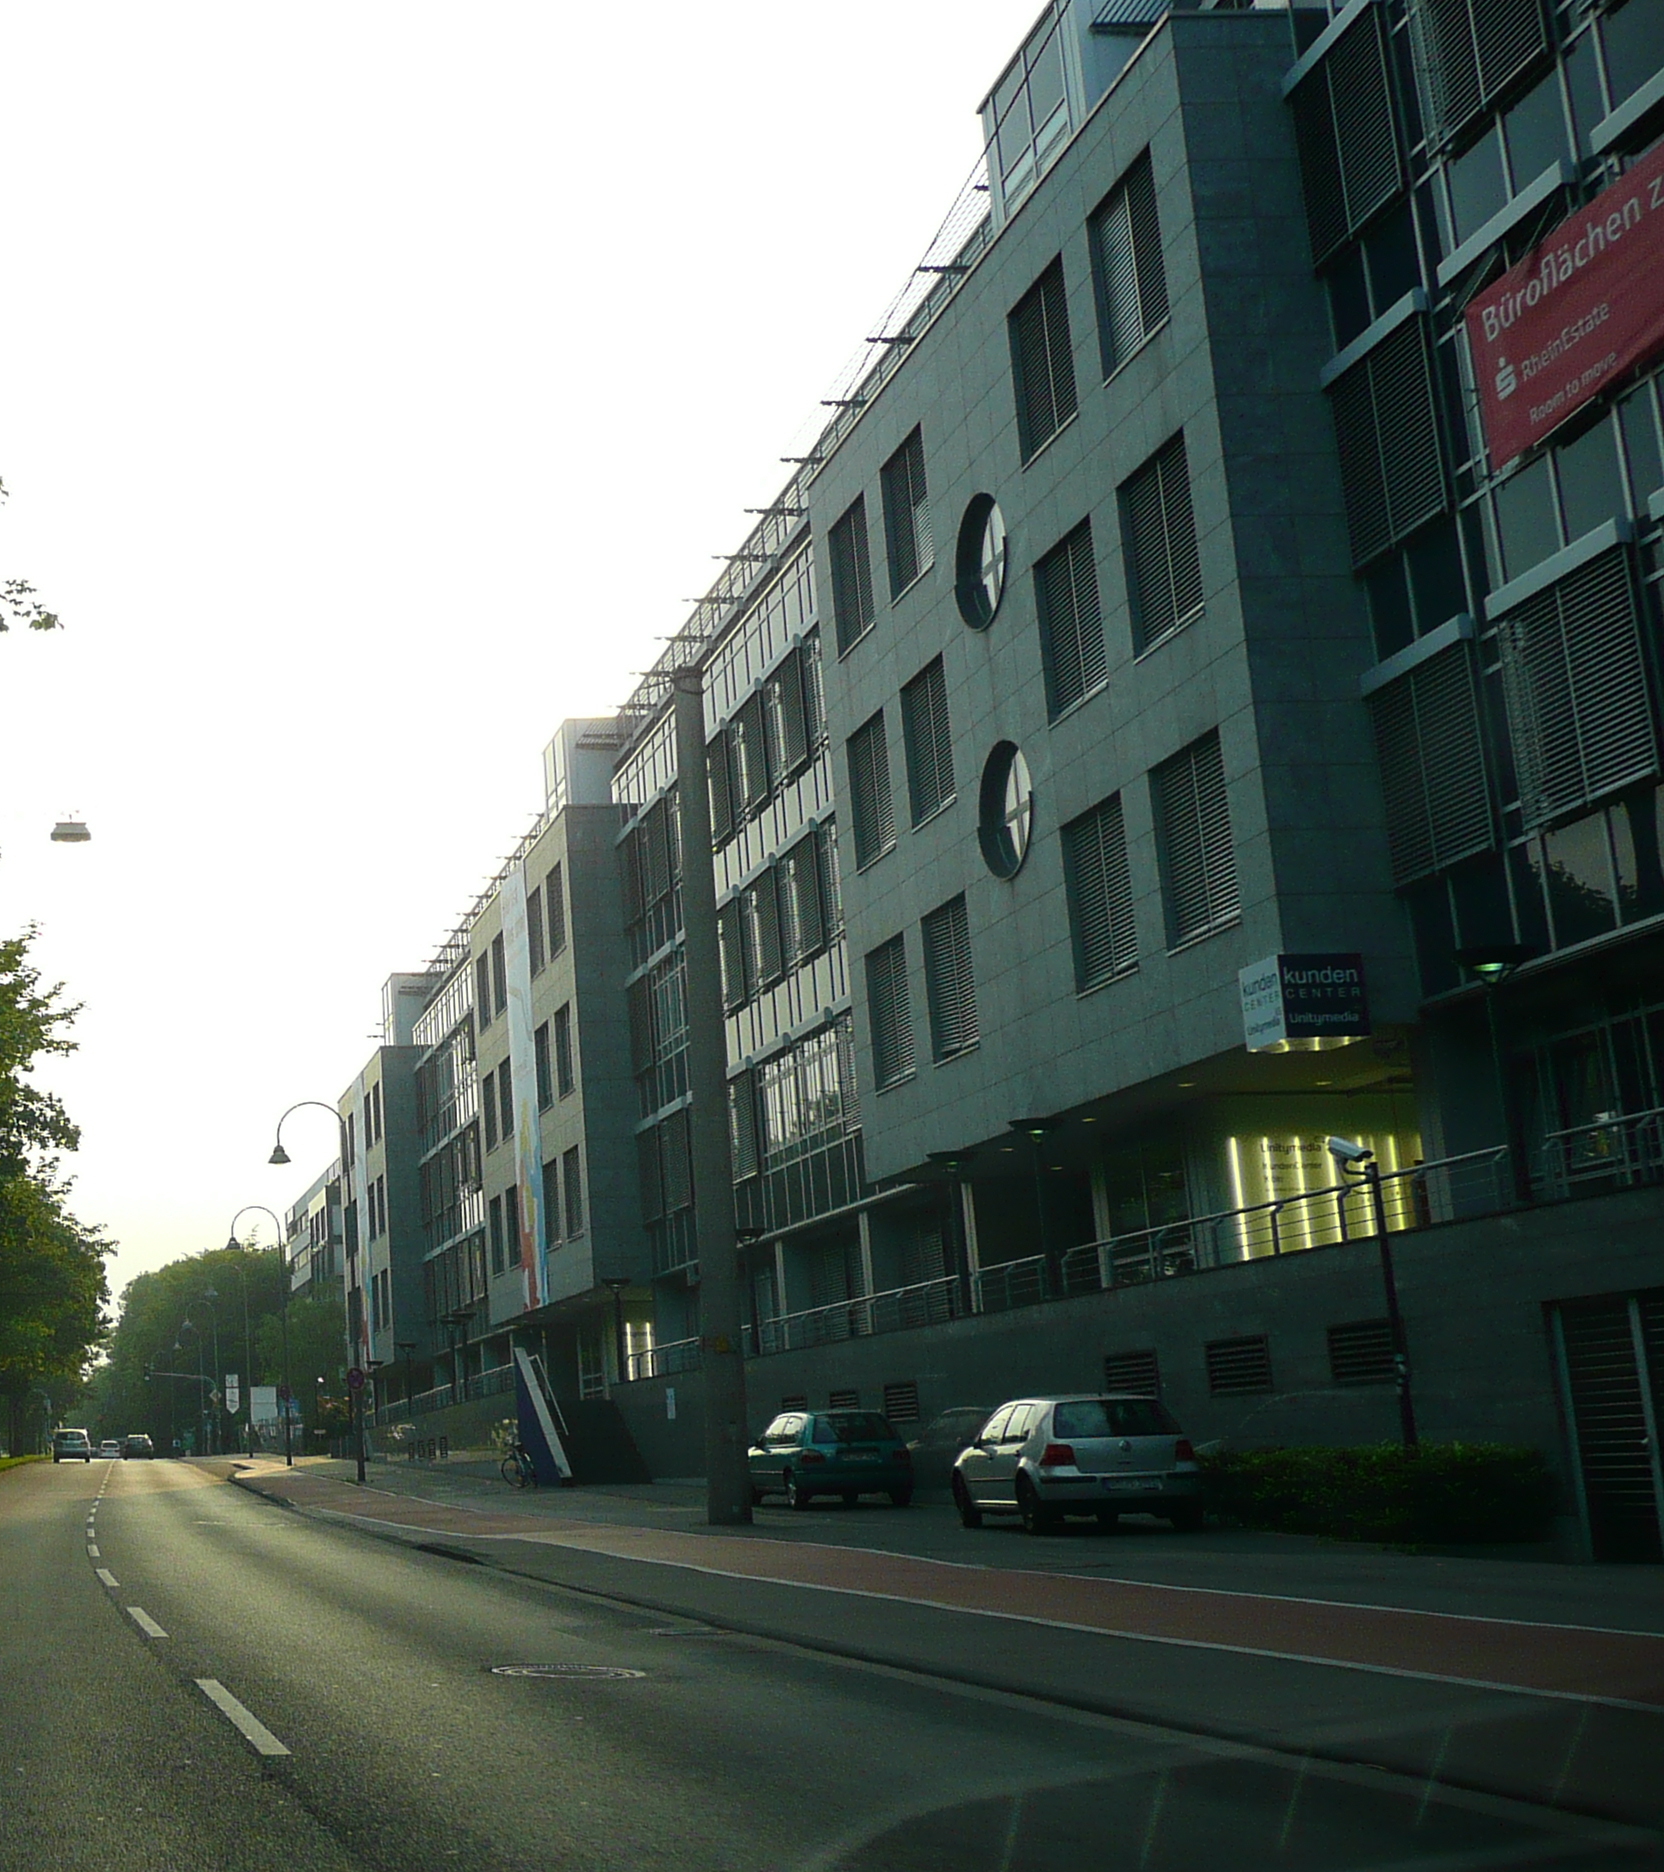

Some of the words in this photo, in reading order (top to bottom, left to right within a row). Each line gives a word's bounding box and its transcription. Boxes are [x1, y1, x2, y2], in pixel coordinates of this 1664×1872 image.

[1481, 197, 1642, 342] Büroflächen
[1521, 302, 1610, 382] RheinEstate
[1529, 391, 1565, 425] Room
[1565, 379, 1580, 398] to
[1581, 351, 1617, 388] move
[1241, 973, 1278, 998] kunden
[1283, 966, 1358, 984] kunden
[1244, 990, 1280, 1012] CENTER
[1285, 986, 1362, 999] CENTER
[1289, 1011, 1360, 1026] Unitymedia
